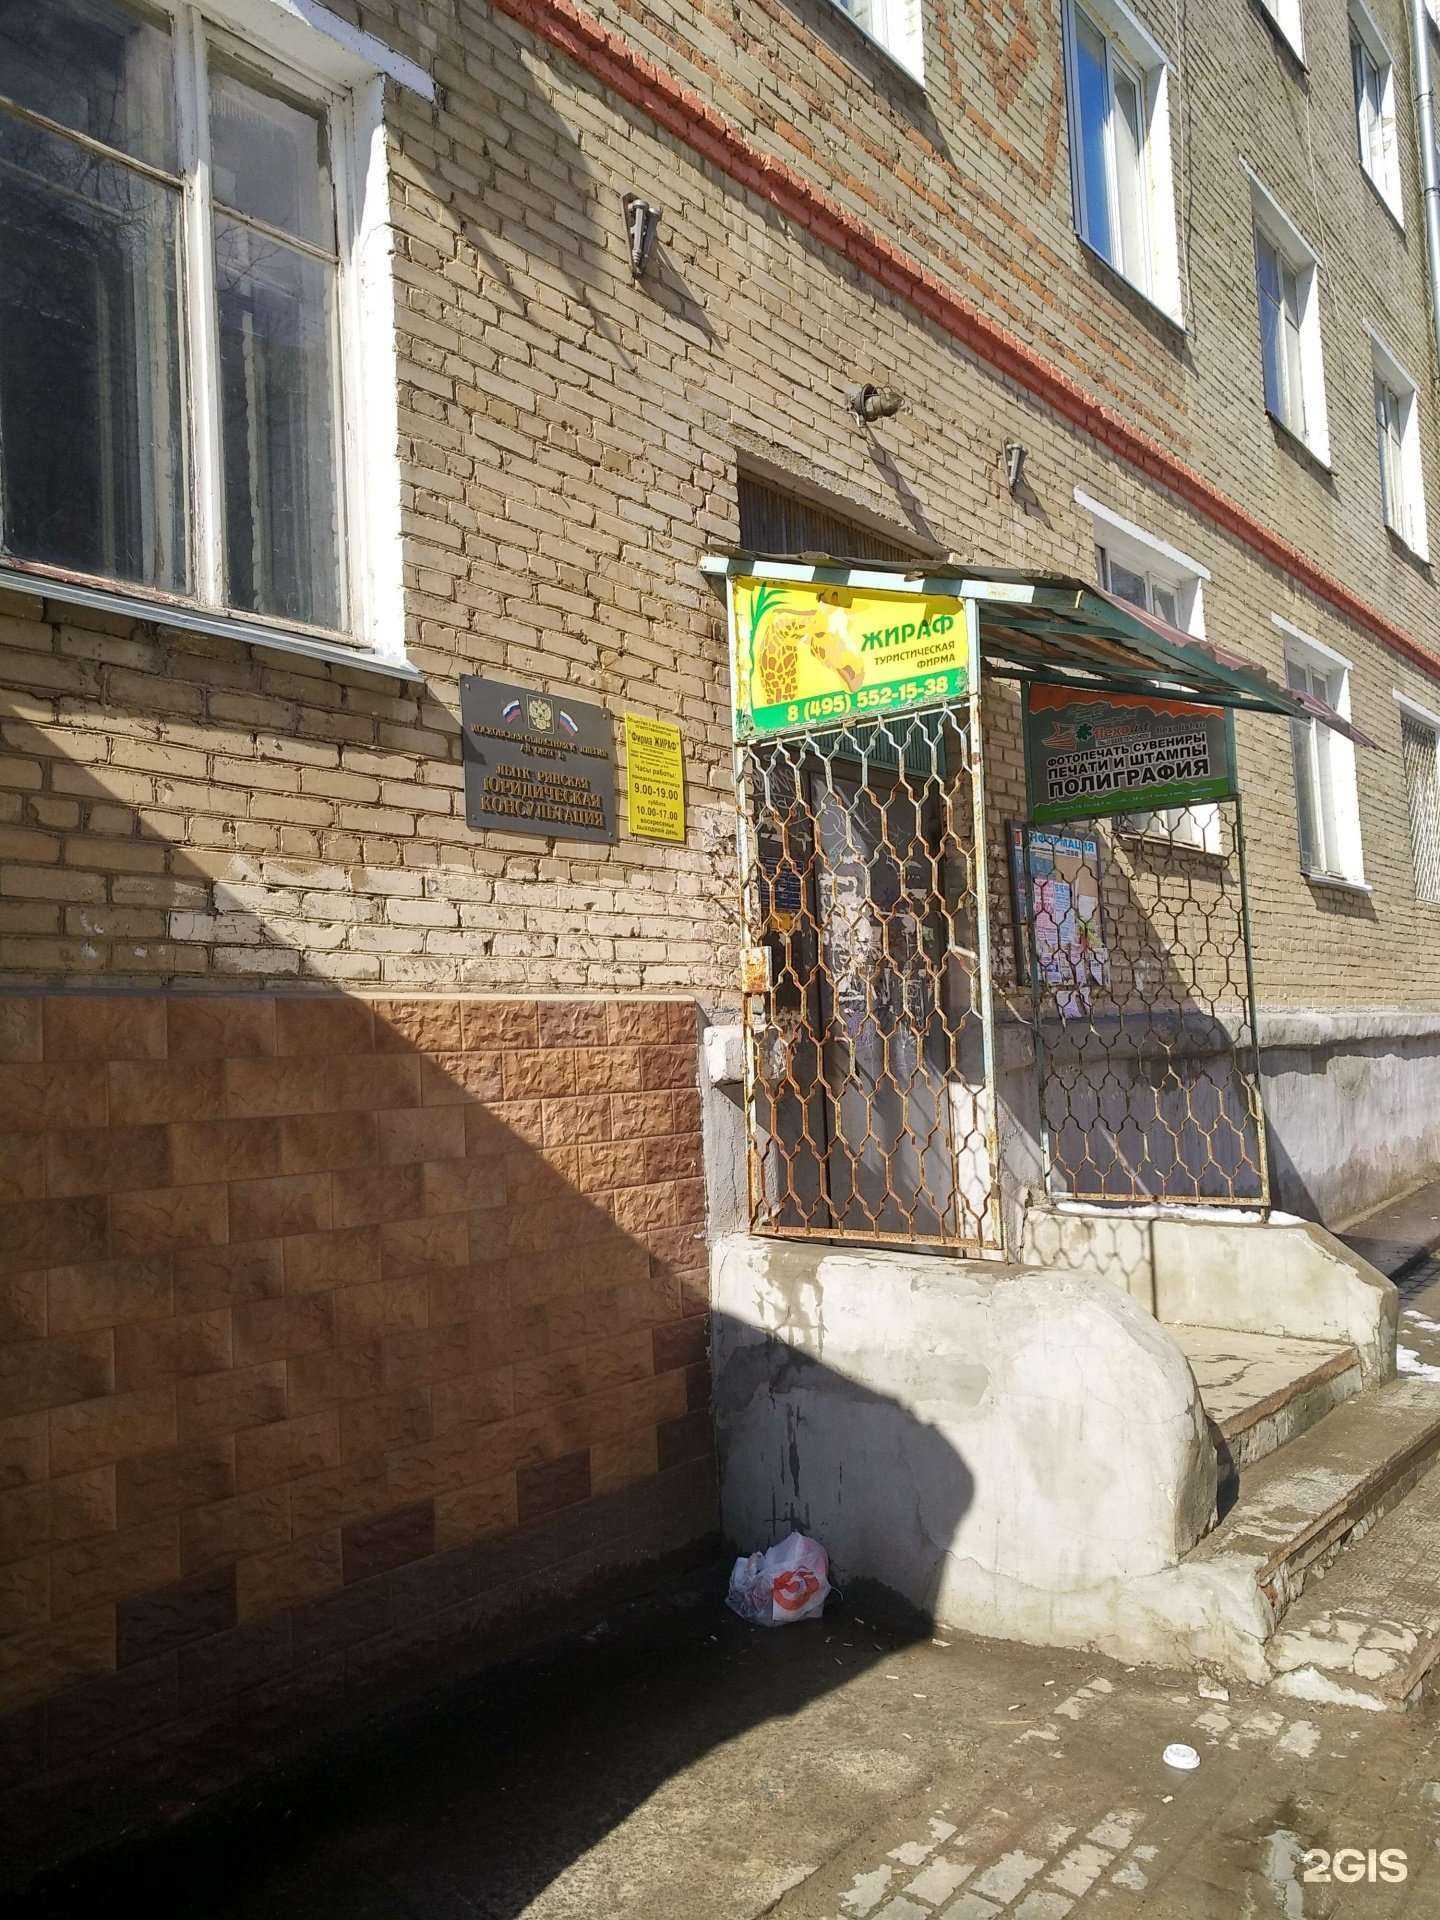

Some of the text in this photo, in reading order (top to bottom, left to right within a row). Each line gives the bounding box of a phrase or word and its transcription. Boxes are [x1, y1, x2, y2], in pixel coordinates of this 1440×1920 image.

[861, 614, 954, 652] ЖИРАФ
[874, 640, 955, 666] ТУРИСТИЧЕСКАЯ
[917, 653, 956, 668] ФИРМА
[787, 675, 948, 722] 8 (495) 552-15-38
[631, 732, 653, 746] Фирма
[1048, 746, 1129, 767] ФОТОПЕЧАТЬ
[1133, 733, 1206, 751] СУВЕНИРЫ
[635, 763, 652, 774] Часы
[1049, 744, 1207, 780] ПЕЧАТИ И ШТАМПЫ
[483, 776, 602, 808] ЮРИДИЧЕСКАЯ
[635, 783, 678, 800] 9.00-19.00
[1049, 758, 1209, 798] ПОЛИГРАФИЯ
[480, 794, 604, 827] КОНСУЛЬТАЦИЯ
[637, 804, 678, 820] 10.00-17.00
[1030, 832, 1095, 853] НФОРМАЦИЯ
